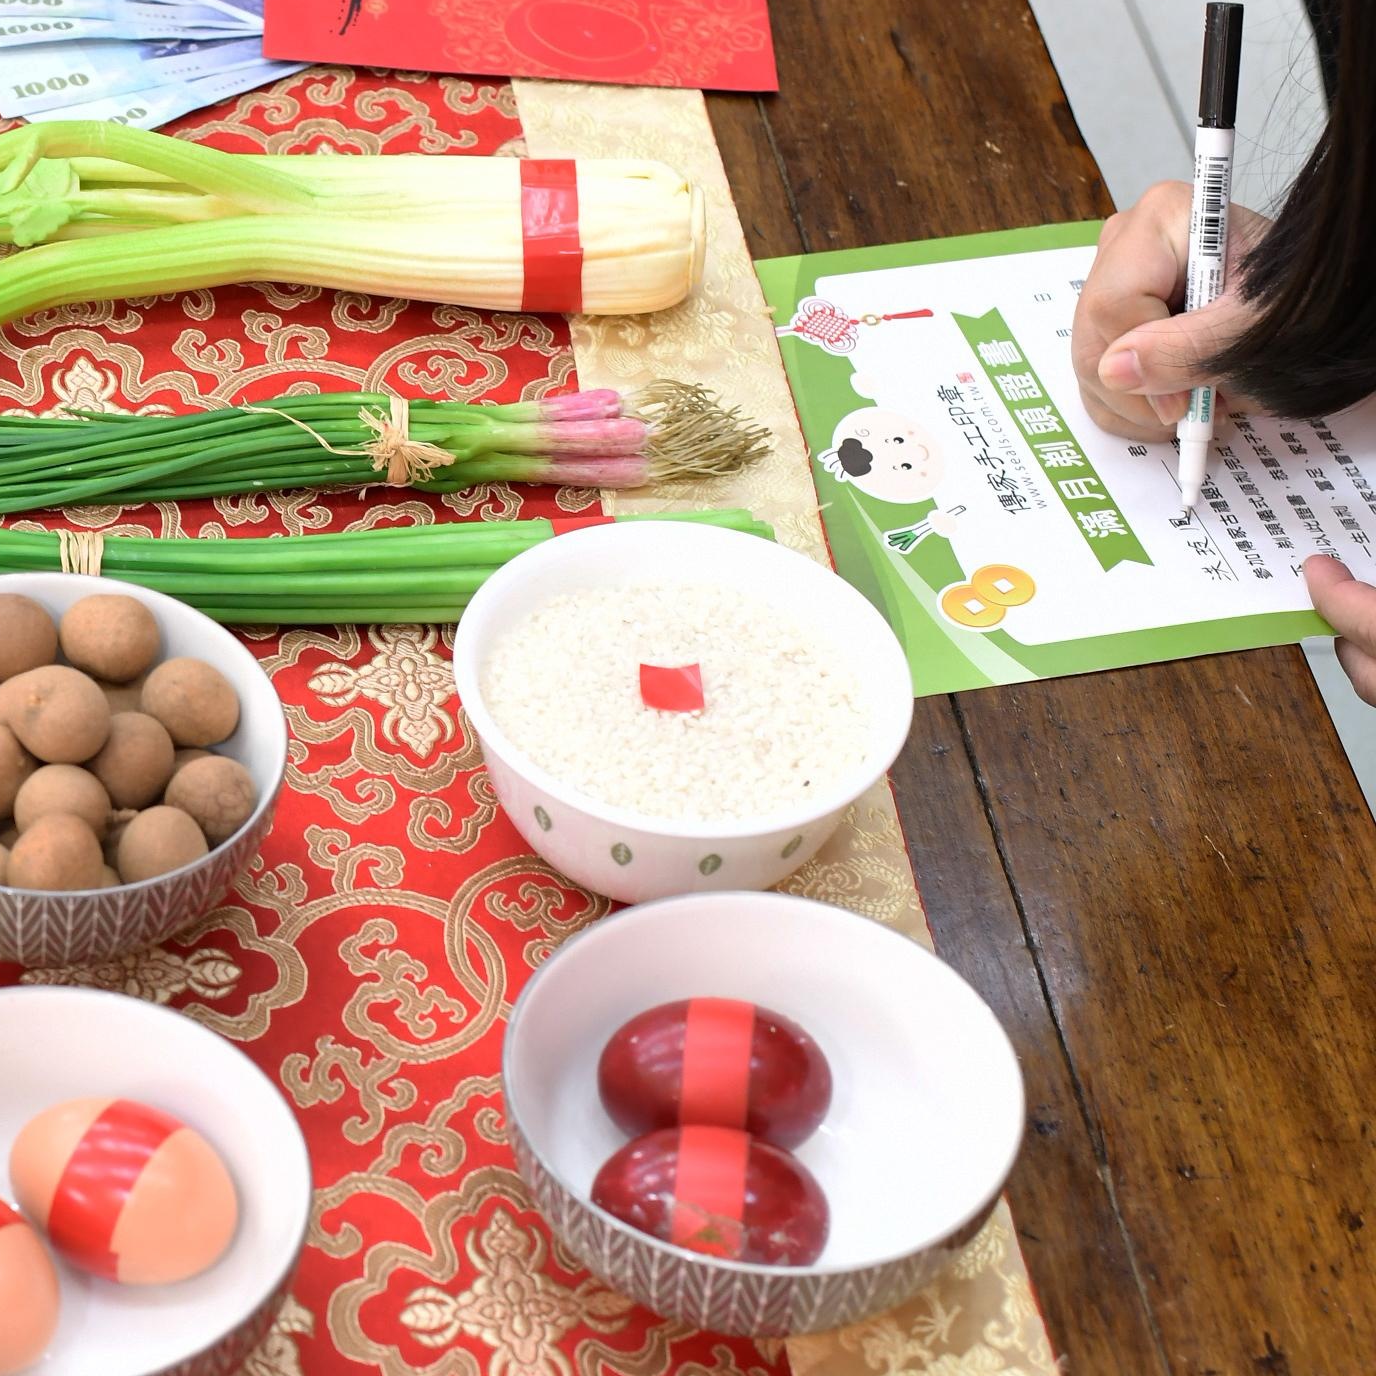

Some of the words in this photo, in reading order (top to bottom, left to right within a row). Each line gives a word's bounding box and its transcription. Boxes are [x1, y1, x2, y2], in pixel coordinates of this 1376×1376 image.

[12, 73, 89, 99] 1000
[937, 385, 1031, 515] 傳家手工印章
[969, 385, 1048, 510] www.seals.com.tw
[975, 335, 1129, 538] 滿月剃頭證書
